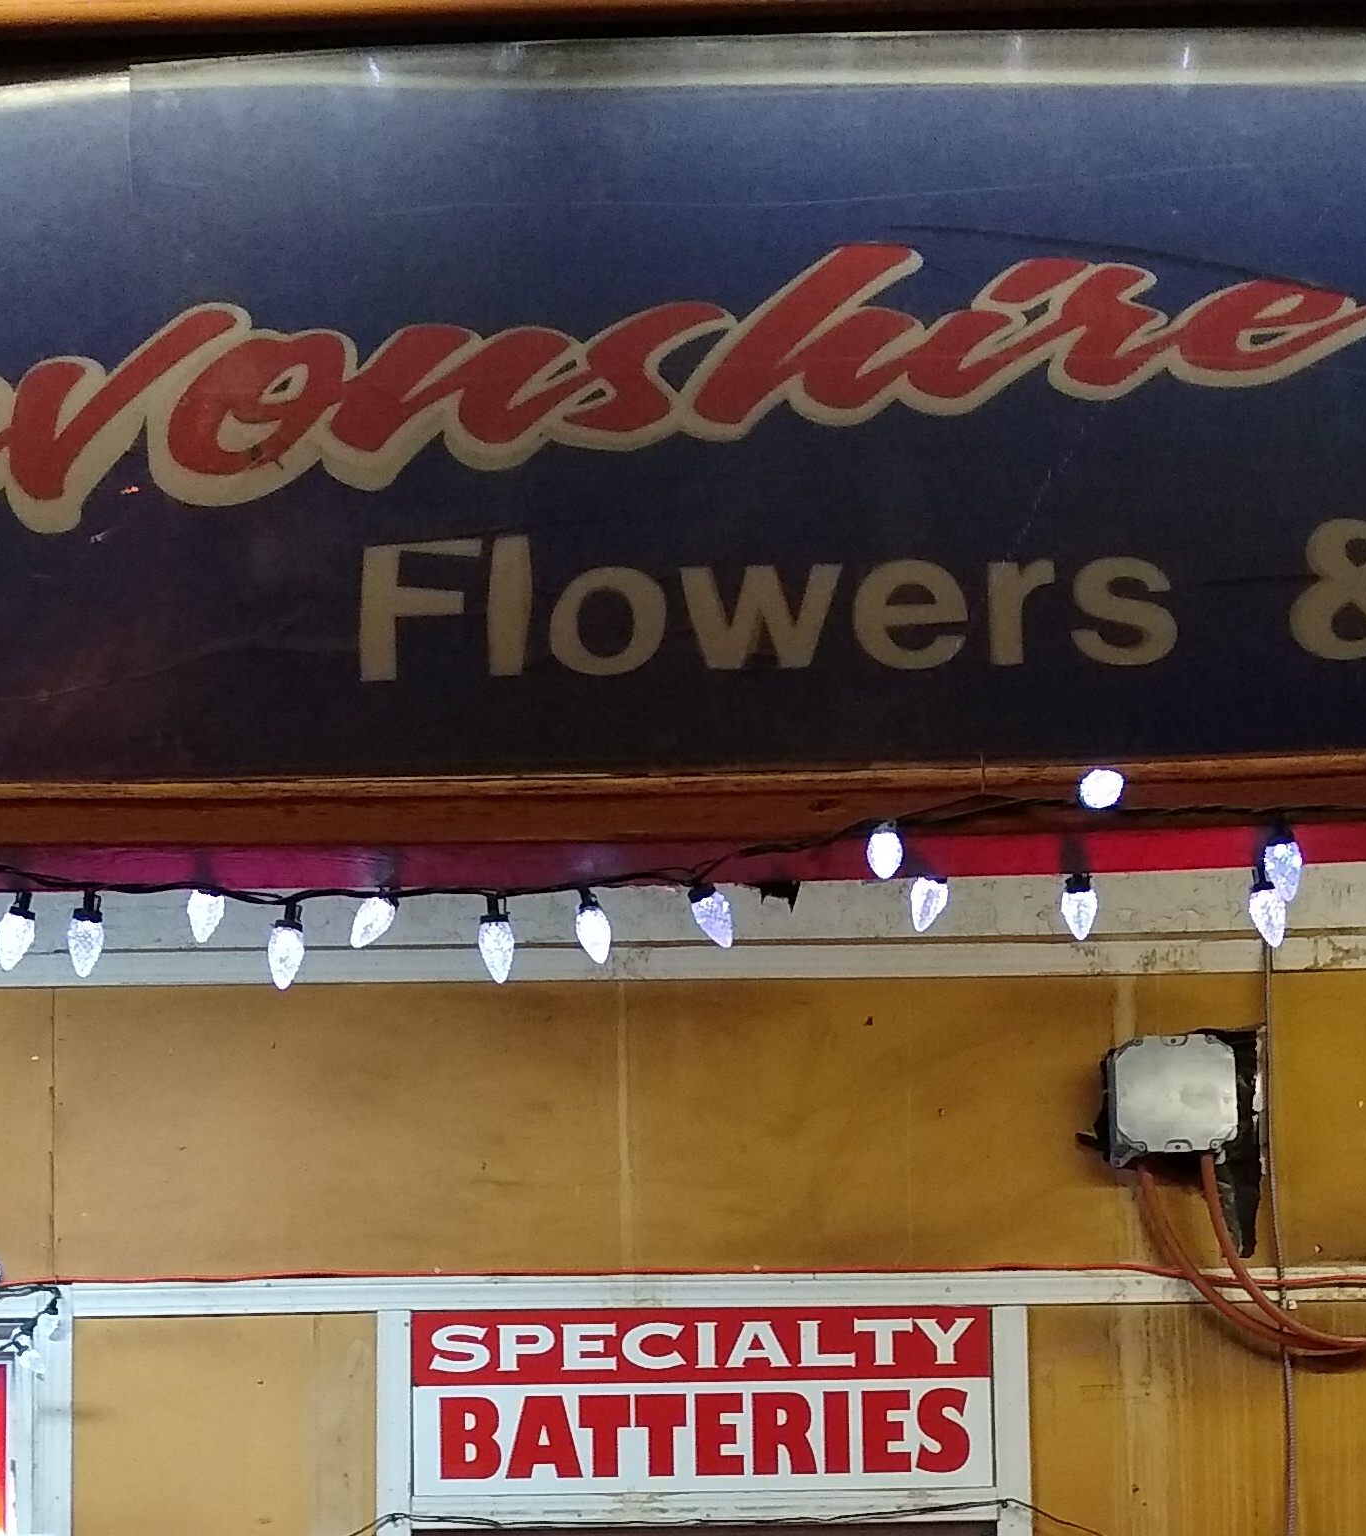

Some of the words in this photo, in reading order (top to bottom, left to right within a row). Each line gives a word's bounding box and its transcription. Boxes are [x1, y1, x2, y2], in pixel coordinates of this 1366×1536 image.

[357, 532, 1180, 682] Flowers
[428, 1316, 976, 1373] SPECIALTY
[439, 1387, 972, 1481] BATTERIES
